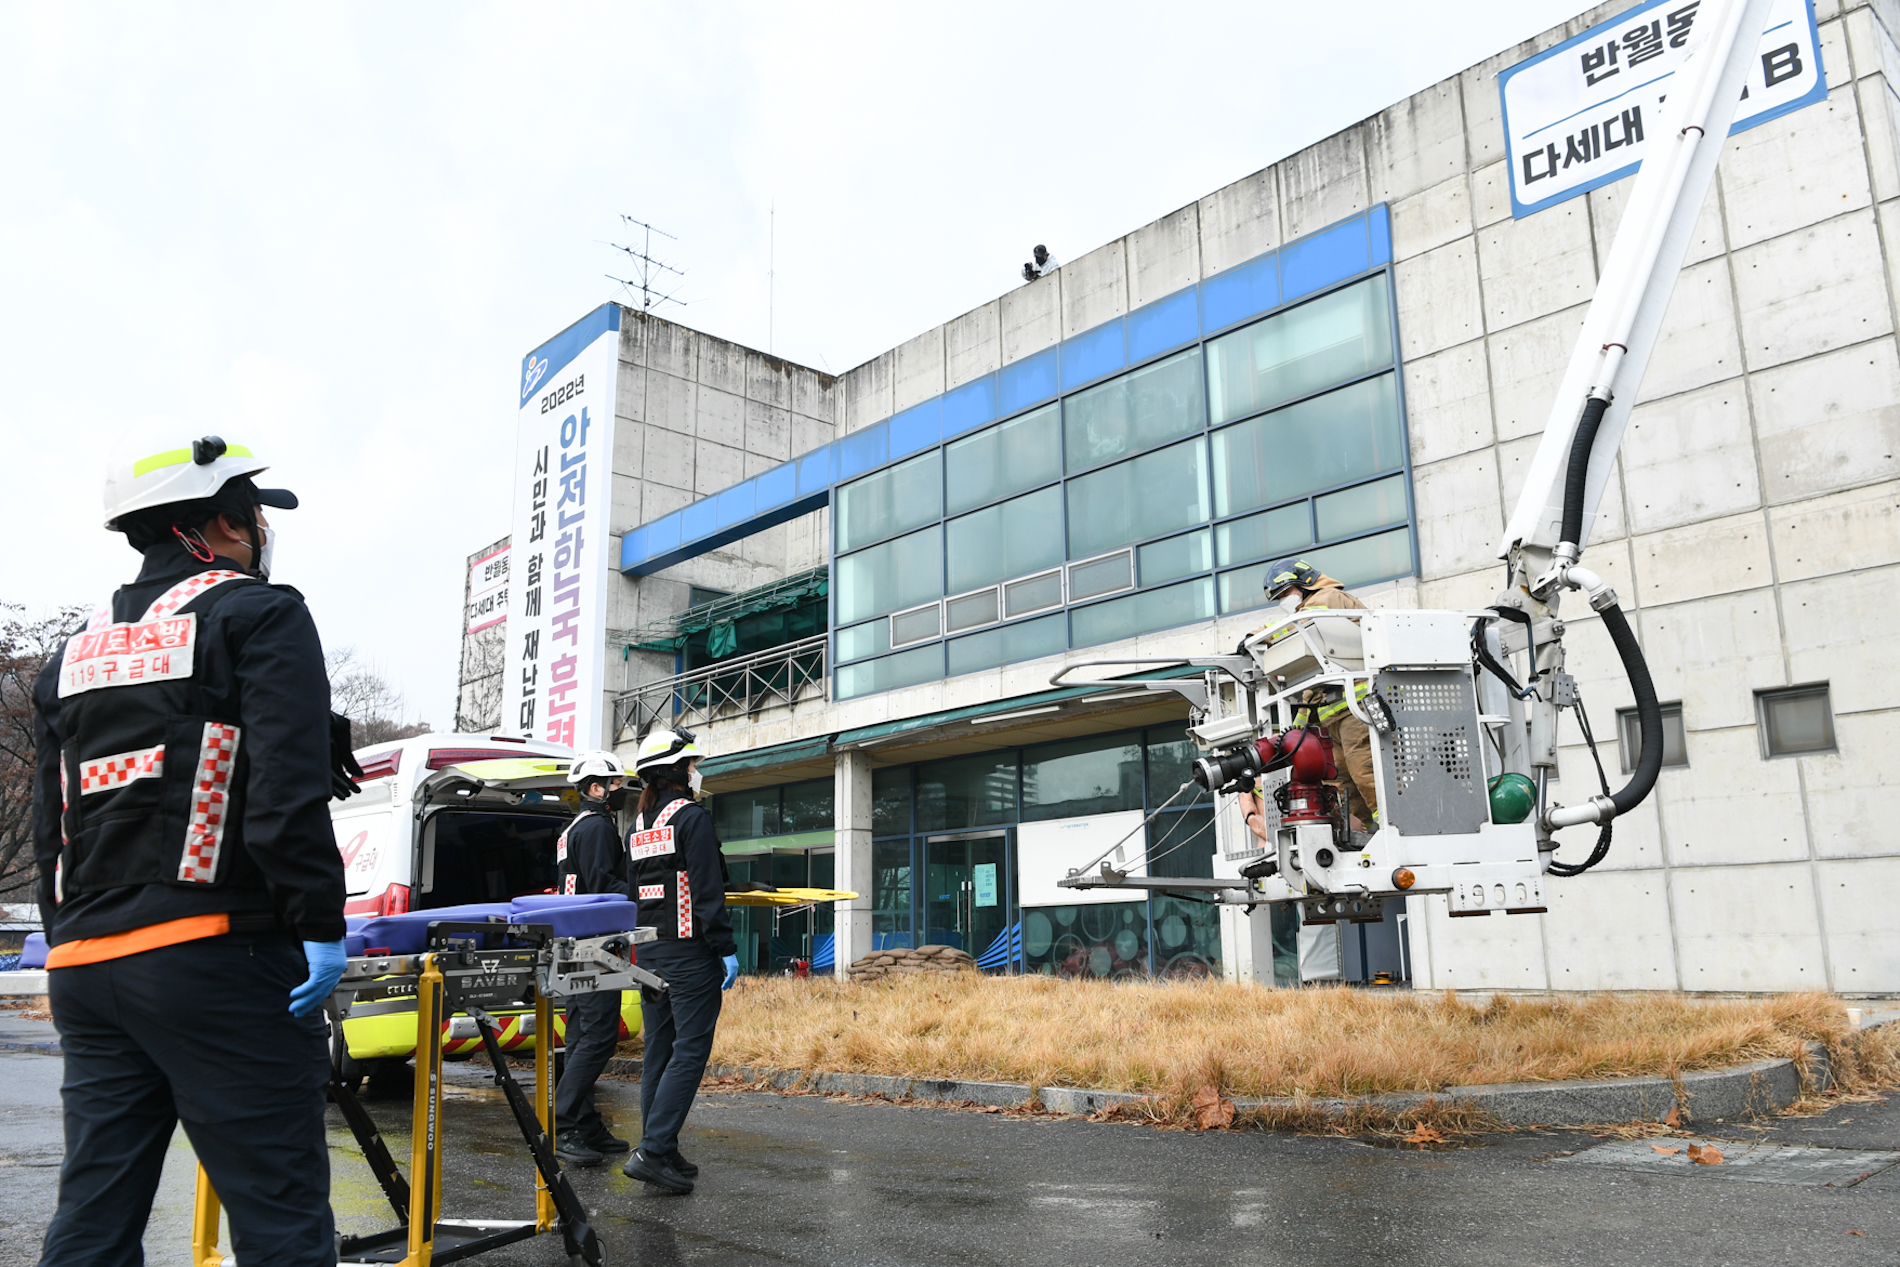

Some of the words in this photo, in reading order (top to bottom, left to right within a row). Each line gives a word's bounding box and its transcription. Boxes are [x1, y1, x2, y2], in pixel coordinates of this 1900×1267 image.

[1522, 105, 1644, 186] 다세대
[1761, 42, 1804, 89] B
[541, 374, 585, 415] 2022년
[529, 445, 549, 544] 시민과
[485, 555, 509, 582] 반월동
[525, 552, 544, 618] 함께
[470, 595, 494, 619] 다세대
[520, 629, 540, 739] 재난대
[461, 974, 518, 989] SAVER
[481, 960, 500, 974] EZ
